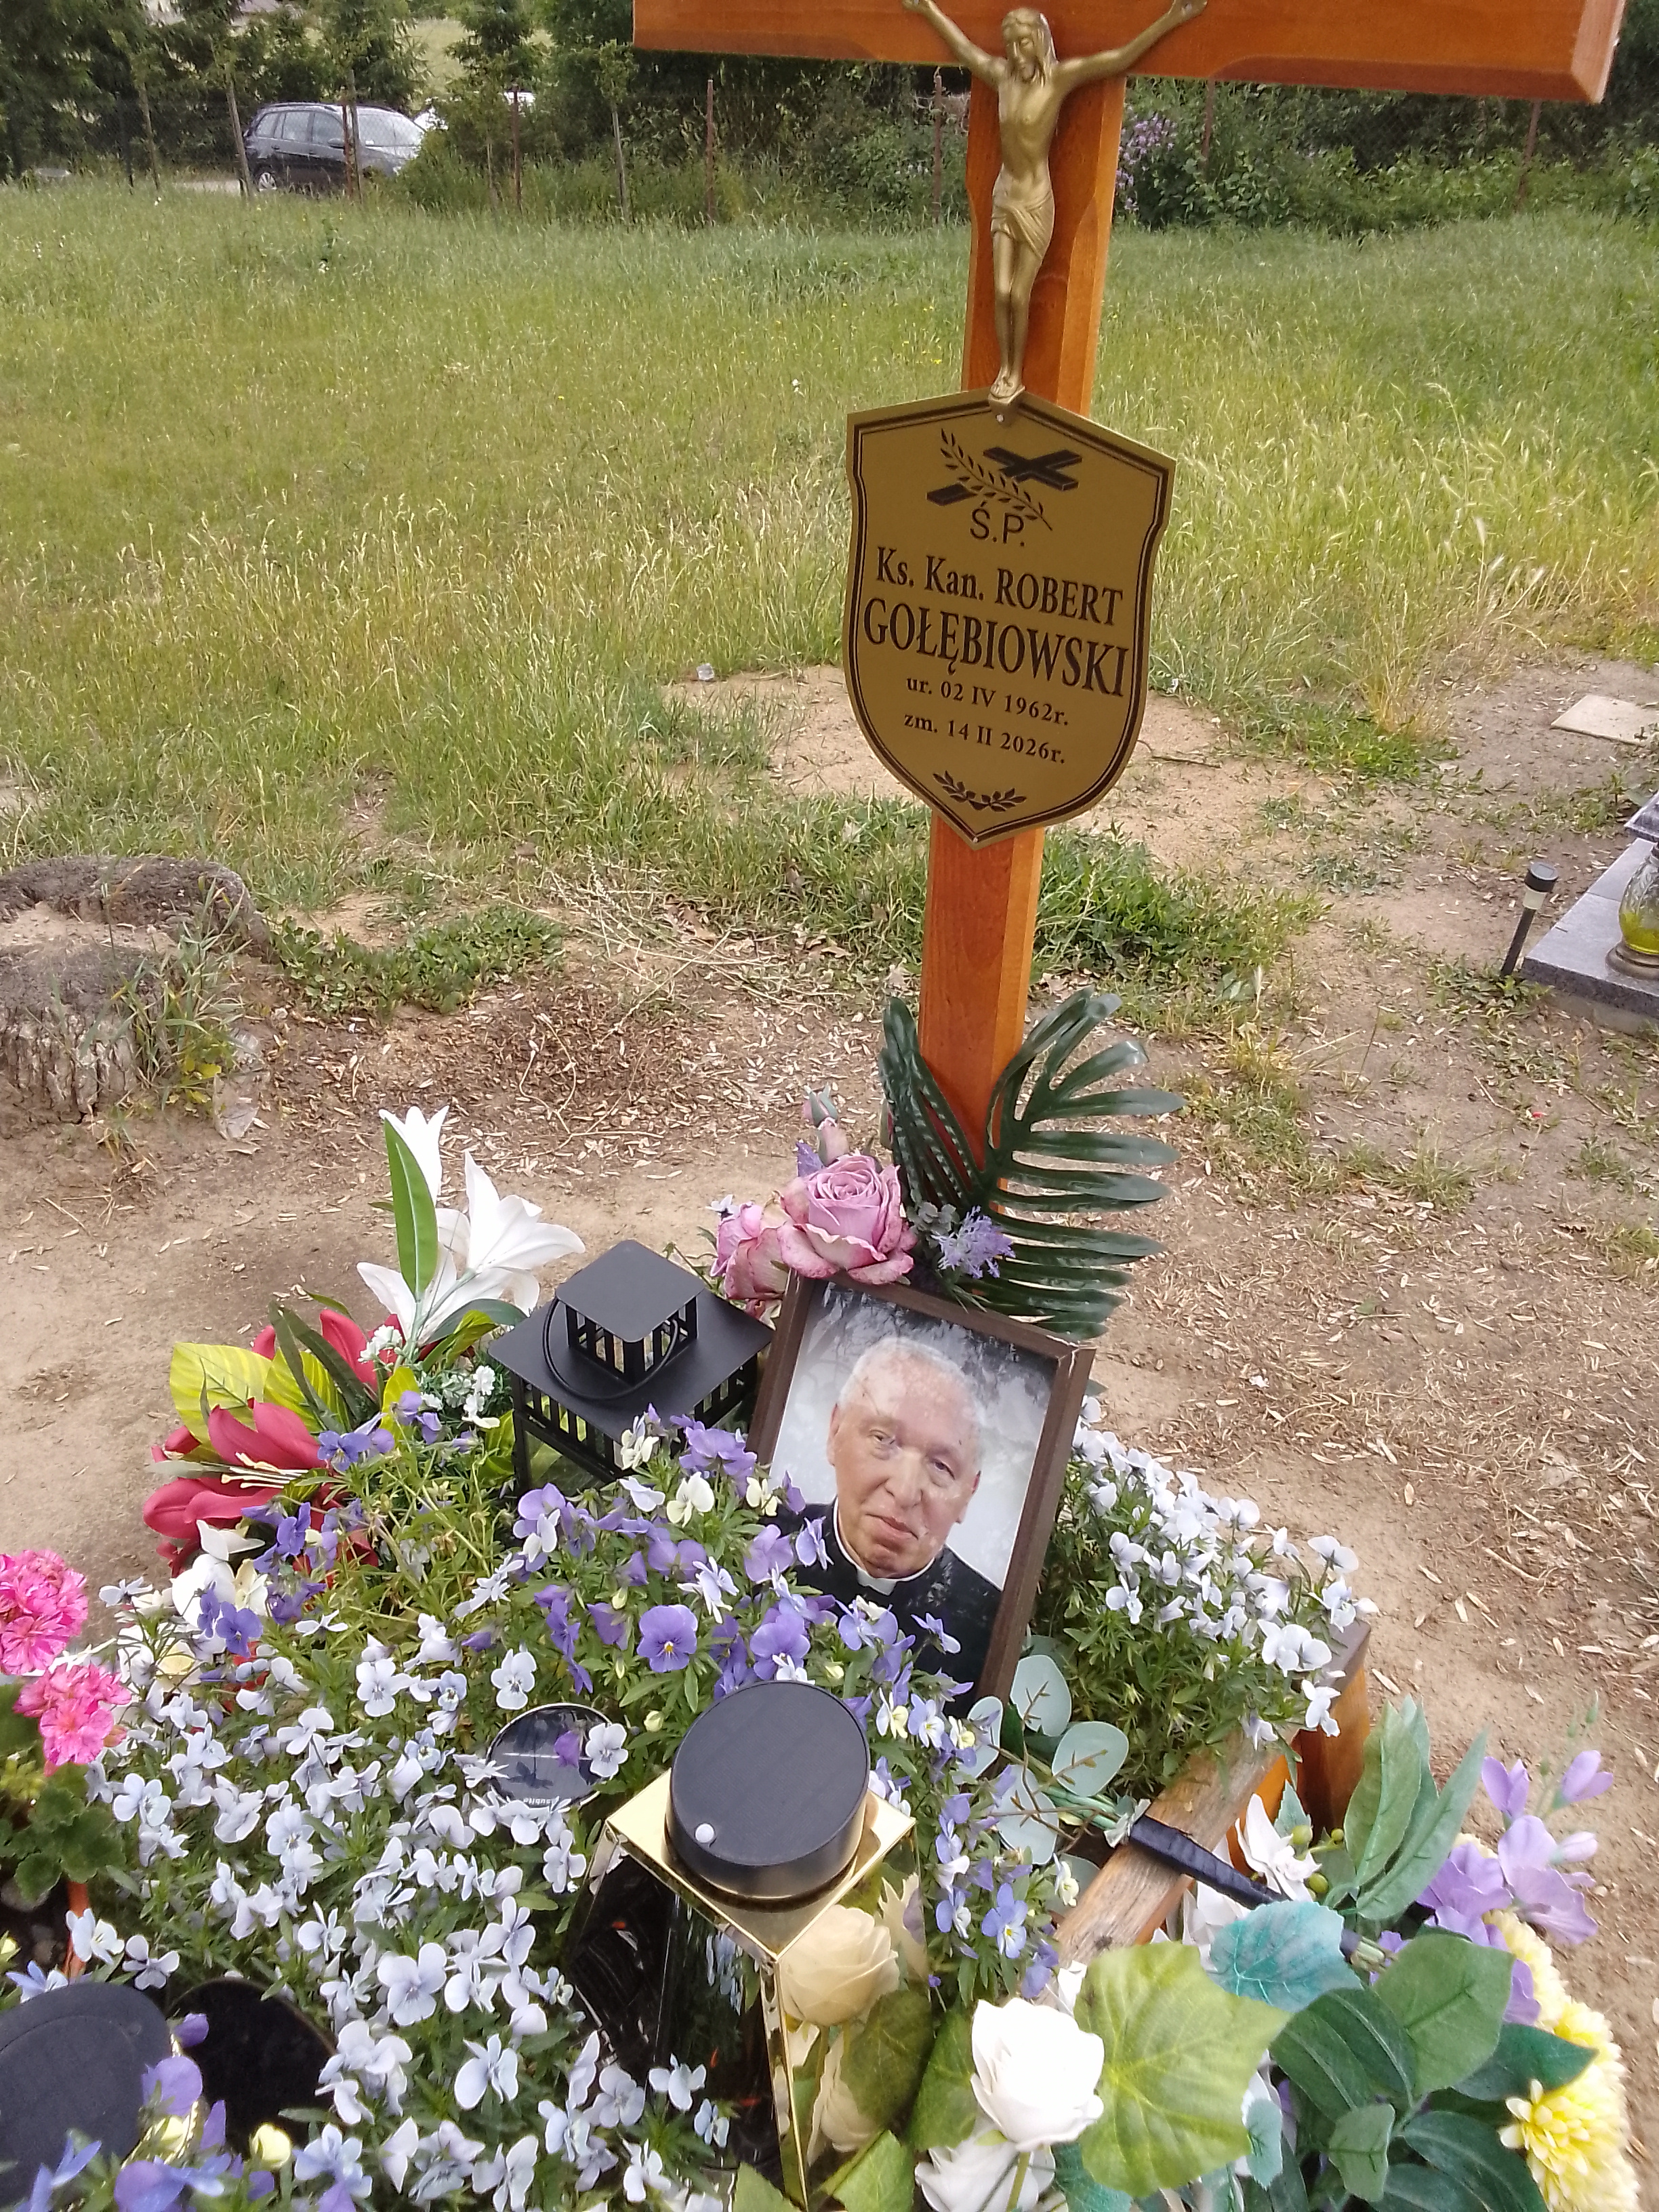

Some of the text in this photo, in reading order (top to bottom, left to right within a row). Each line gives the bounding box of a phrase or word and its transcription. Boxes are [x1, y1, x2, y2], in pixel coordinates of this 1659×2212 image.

[877, 547, 1123, 626] Ks. Kan. ROBERT
[863, 597, 1129, 697] GOŁĘBIOWSKI
[907, 679, 1069, 726] ur. 02 IV 1962r.
[904, 714, 1065, 764] zm. 14 II 2026r.
